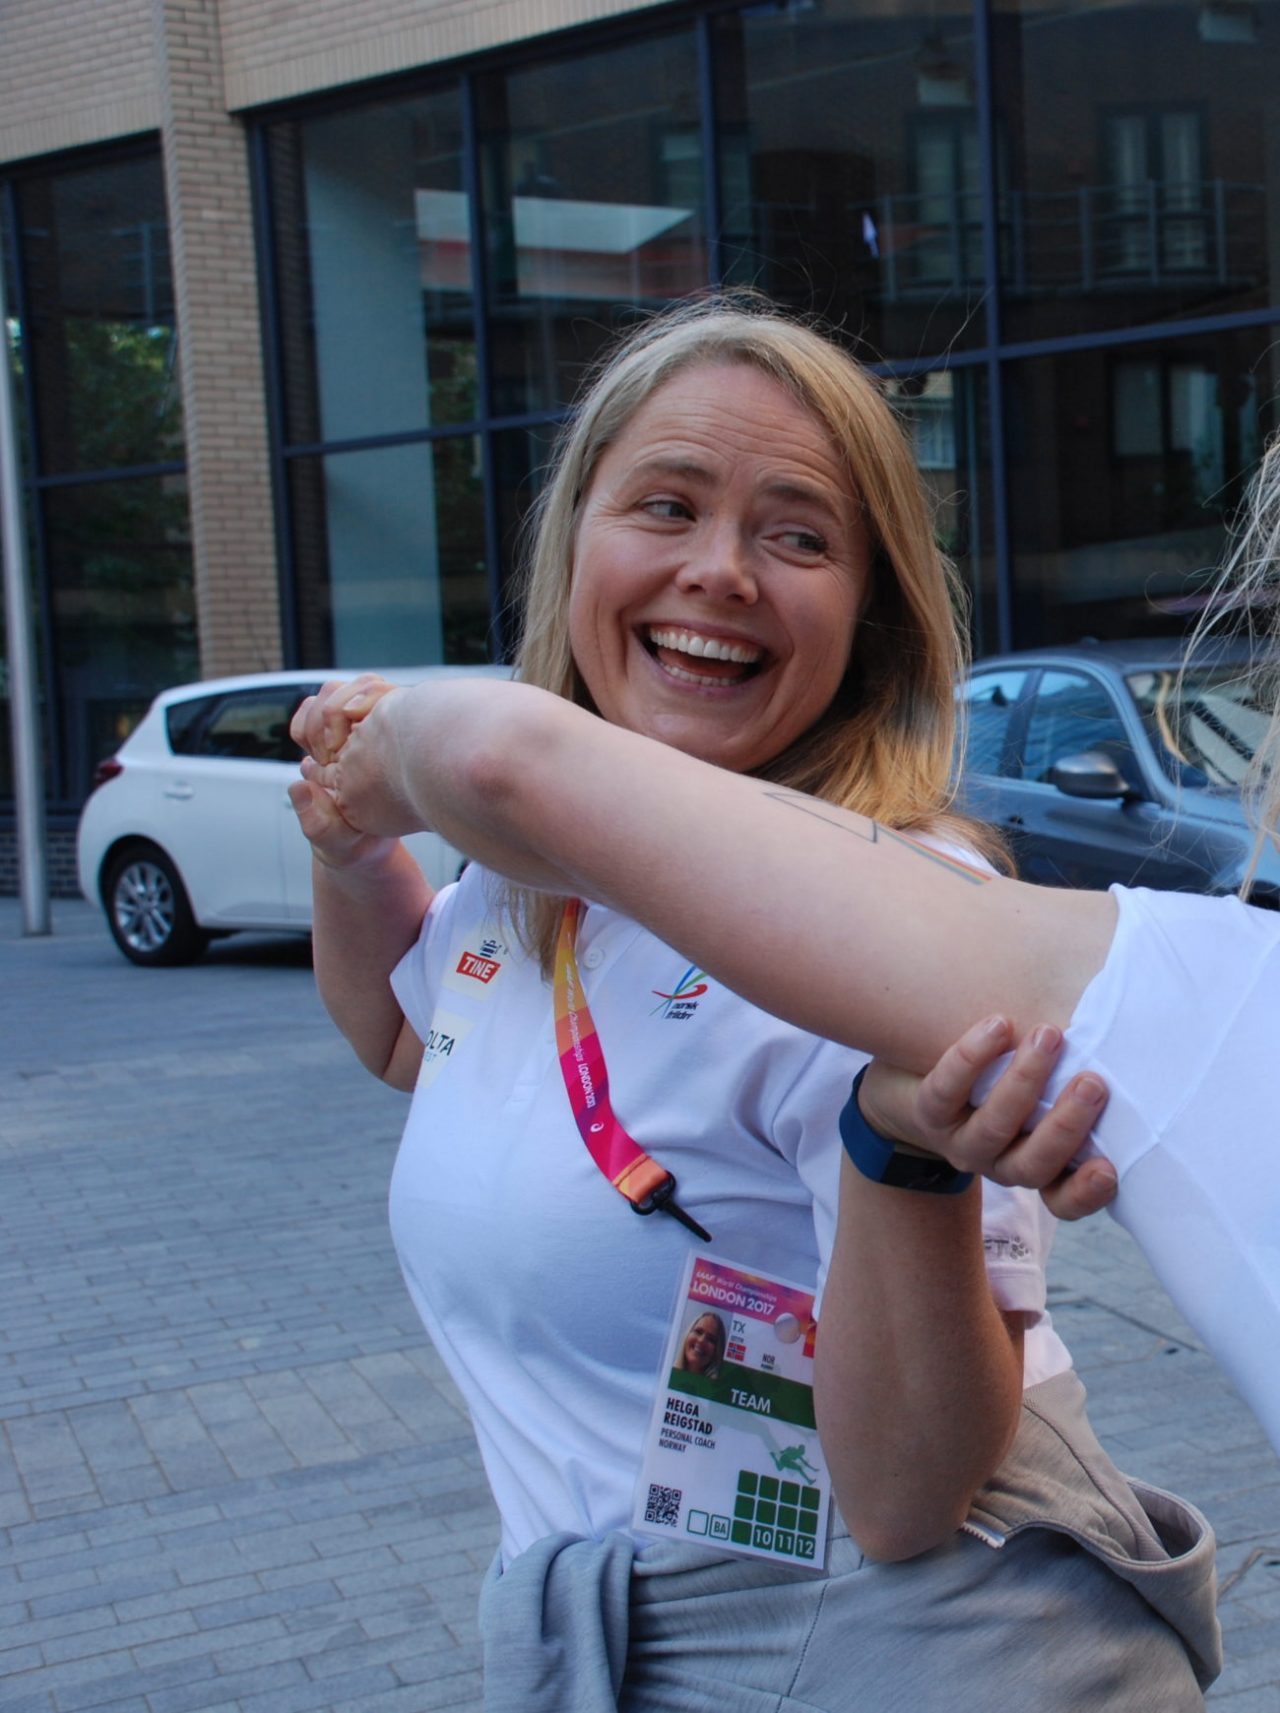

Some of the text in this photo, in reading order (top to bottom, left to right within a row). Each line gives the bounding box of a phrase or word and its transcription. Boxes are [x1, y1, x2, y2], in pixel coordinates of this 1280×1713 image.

[462, 956, 496, 980] TINE
[426, 1029, 456, 1056] OLTA
[577, 1063, 594, 1094] LONDON
[692, 1280, 776, 1316] LONDON 2017
[732, 1320, 746, 1334] TX
[761, 1352, 776, 1365] NOR
[666, 1397, 699, 1417] HELGA
[730, 1388, 771, 1414] TEAM
[663, 1411, 713, 1435] REIGSTAD
[658, 1438, 687, 1453] NORWAY
[660, 1427, 716, 1450] PERSONAL COACH
[713, 1520, 727, 1535] BA
[755, 1528, 814, 1556] 10 11 12
